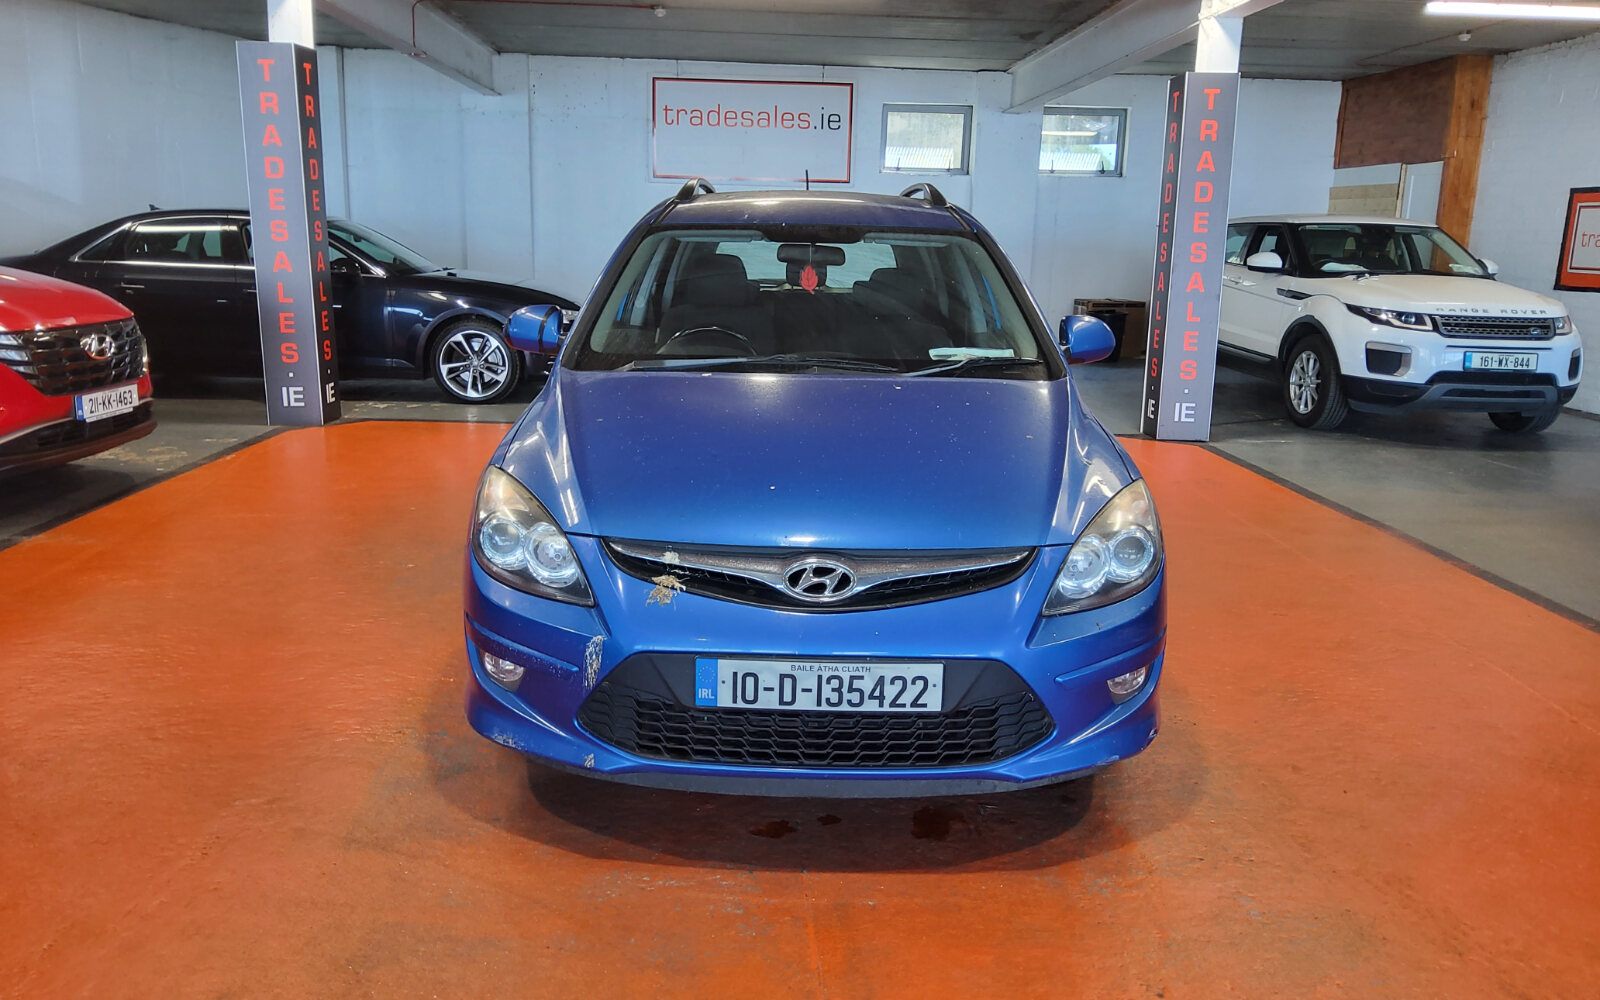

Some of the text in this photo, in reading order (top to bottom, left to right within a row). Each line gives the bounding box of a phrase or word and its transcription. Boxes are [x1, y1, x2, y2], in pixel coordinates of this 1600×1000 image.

[663, 103, 841, 131] tradesales.ie
[1480, 355, 1530, 368] 161-WX-844
[790, 664, 815, 672] BAILE
[841, 665, 871, 673] CLIATH
[698, 688, 715, 699] IRL
